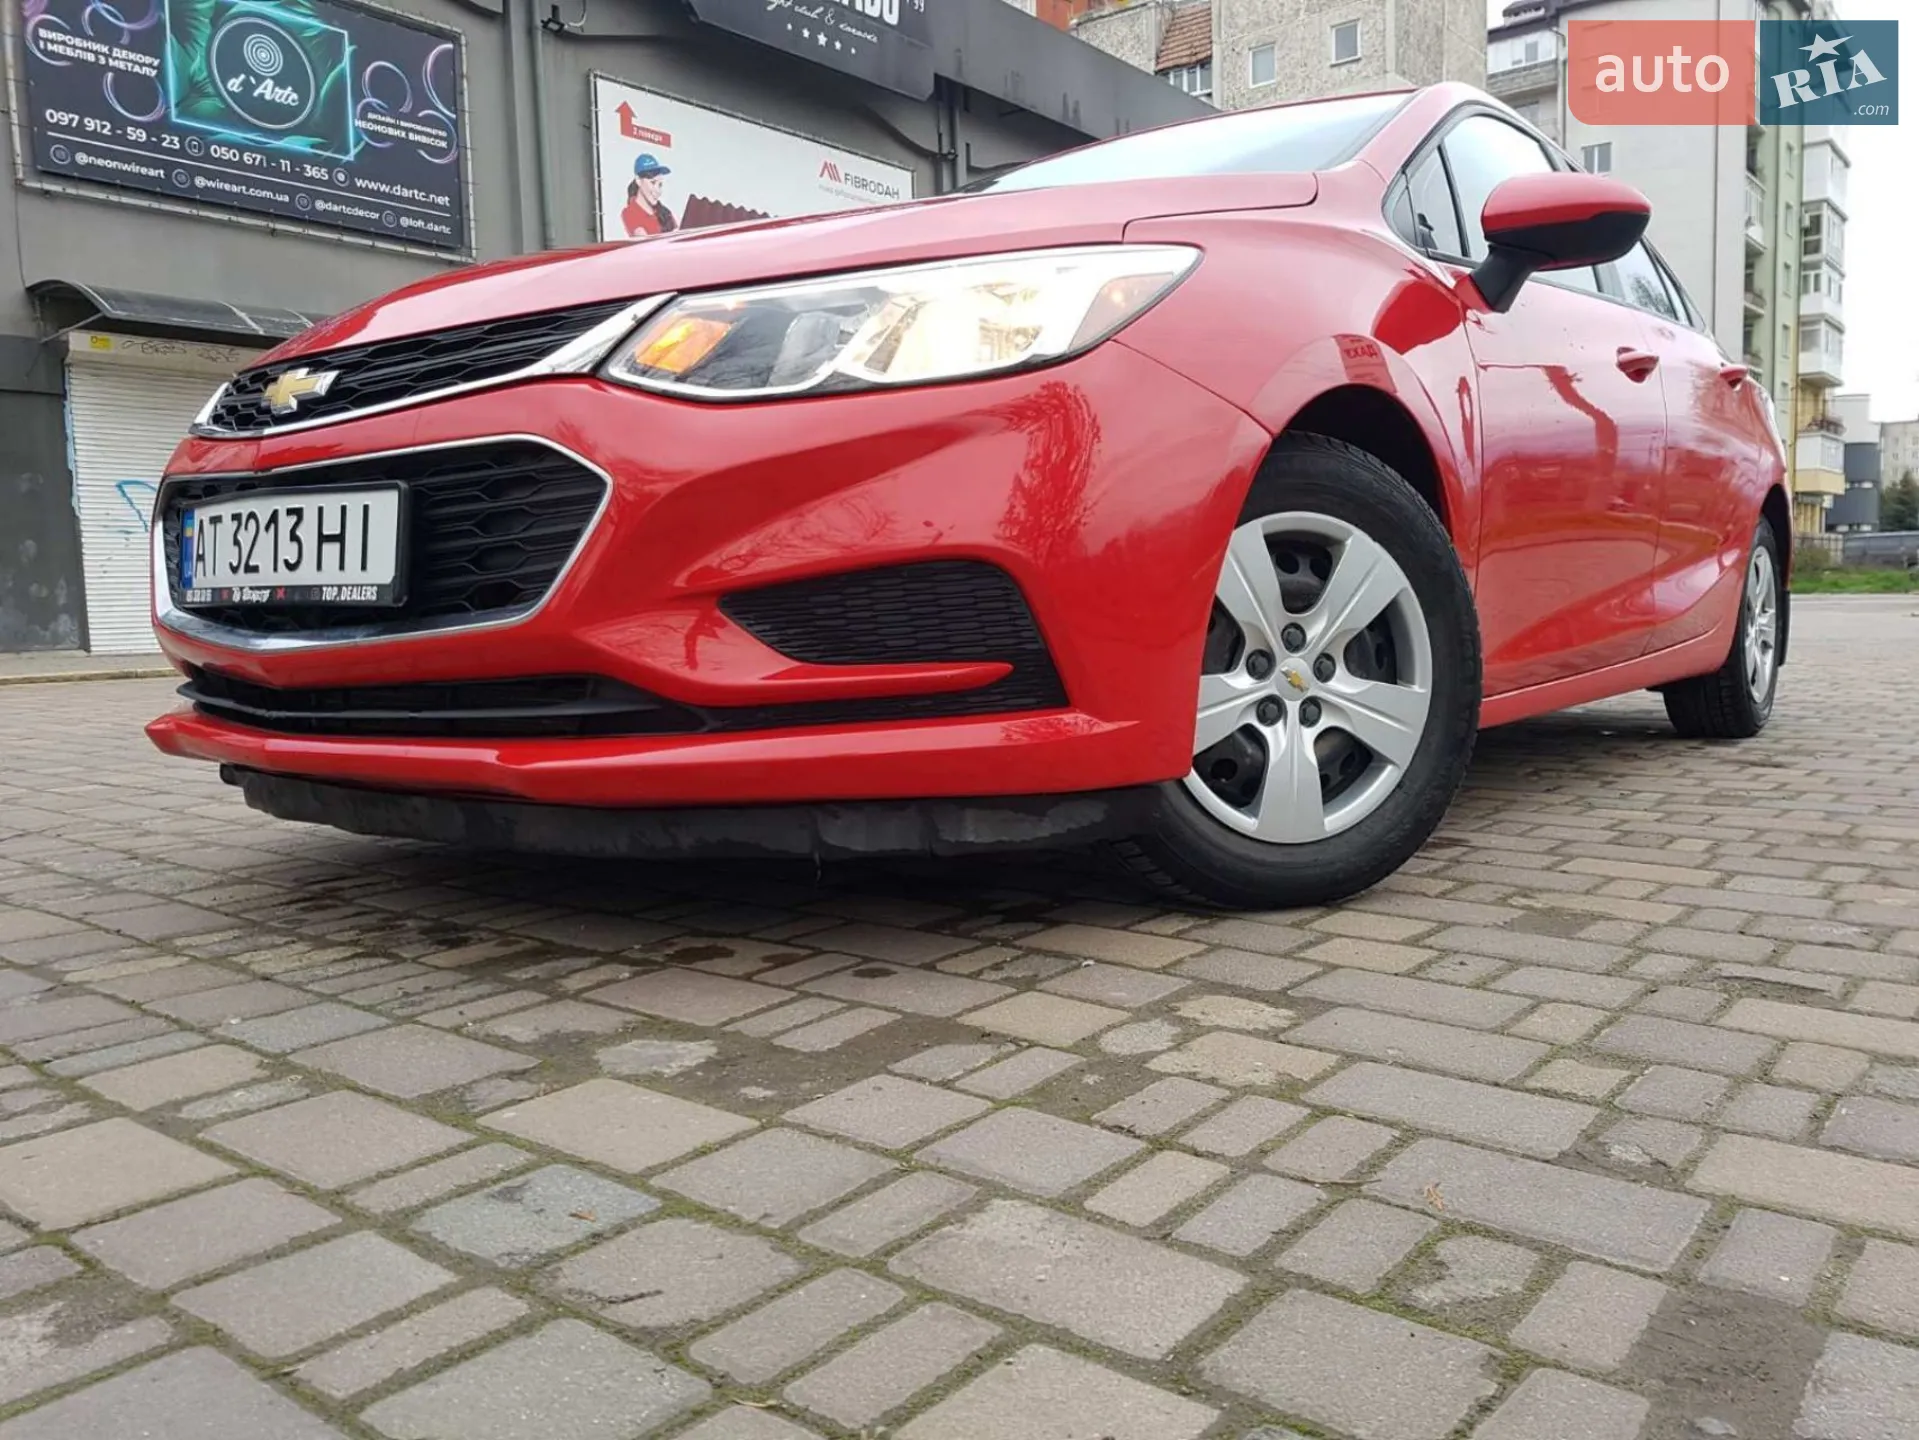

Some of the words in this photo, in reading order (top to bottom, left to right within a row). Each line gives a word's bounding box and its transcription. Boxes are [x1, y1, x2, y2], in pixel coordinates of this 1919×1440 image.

[824, 8, 836, 26] &
[37, 27, 110, 55] ВИРОБНИК
[111, 46, 161, 67] ДЕКОРУ
[46, 43, 97, 63] МЕБЛІВ
[108, 57, 158, 77] МЕТАЛУ
[45, 108, 80, 128] 097
[84, 117, 112, 136] 912
[126, 126, 148, 143] 59
[161, 134, 181, 150] 23
[354, 118, 407, 139] НЕОНОВИХ
[408, 131, 448, 149] ВИВІСОК
[74, 151, 166, 179] @neonwireart
[210, 144, 240, 162] 050
[243, 151, 268, 169] 671
[280, 158, 291, 174] 11
[303, 163, 329, 181] 365
[194, 175, 290, 203] @wireart.com.ua
[354, 177, 451, 208] www.dartc.net
[844, 172, 900, 199] FIBRODAH
[314, 199, 380, 220] @dartcdecor
[194, 514, 223, 578] AT
[228, 506, 304, 575] 3213
